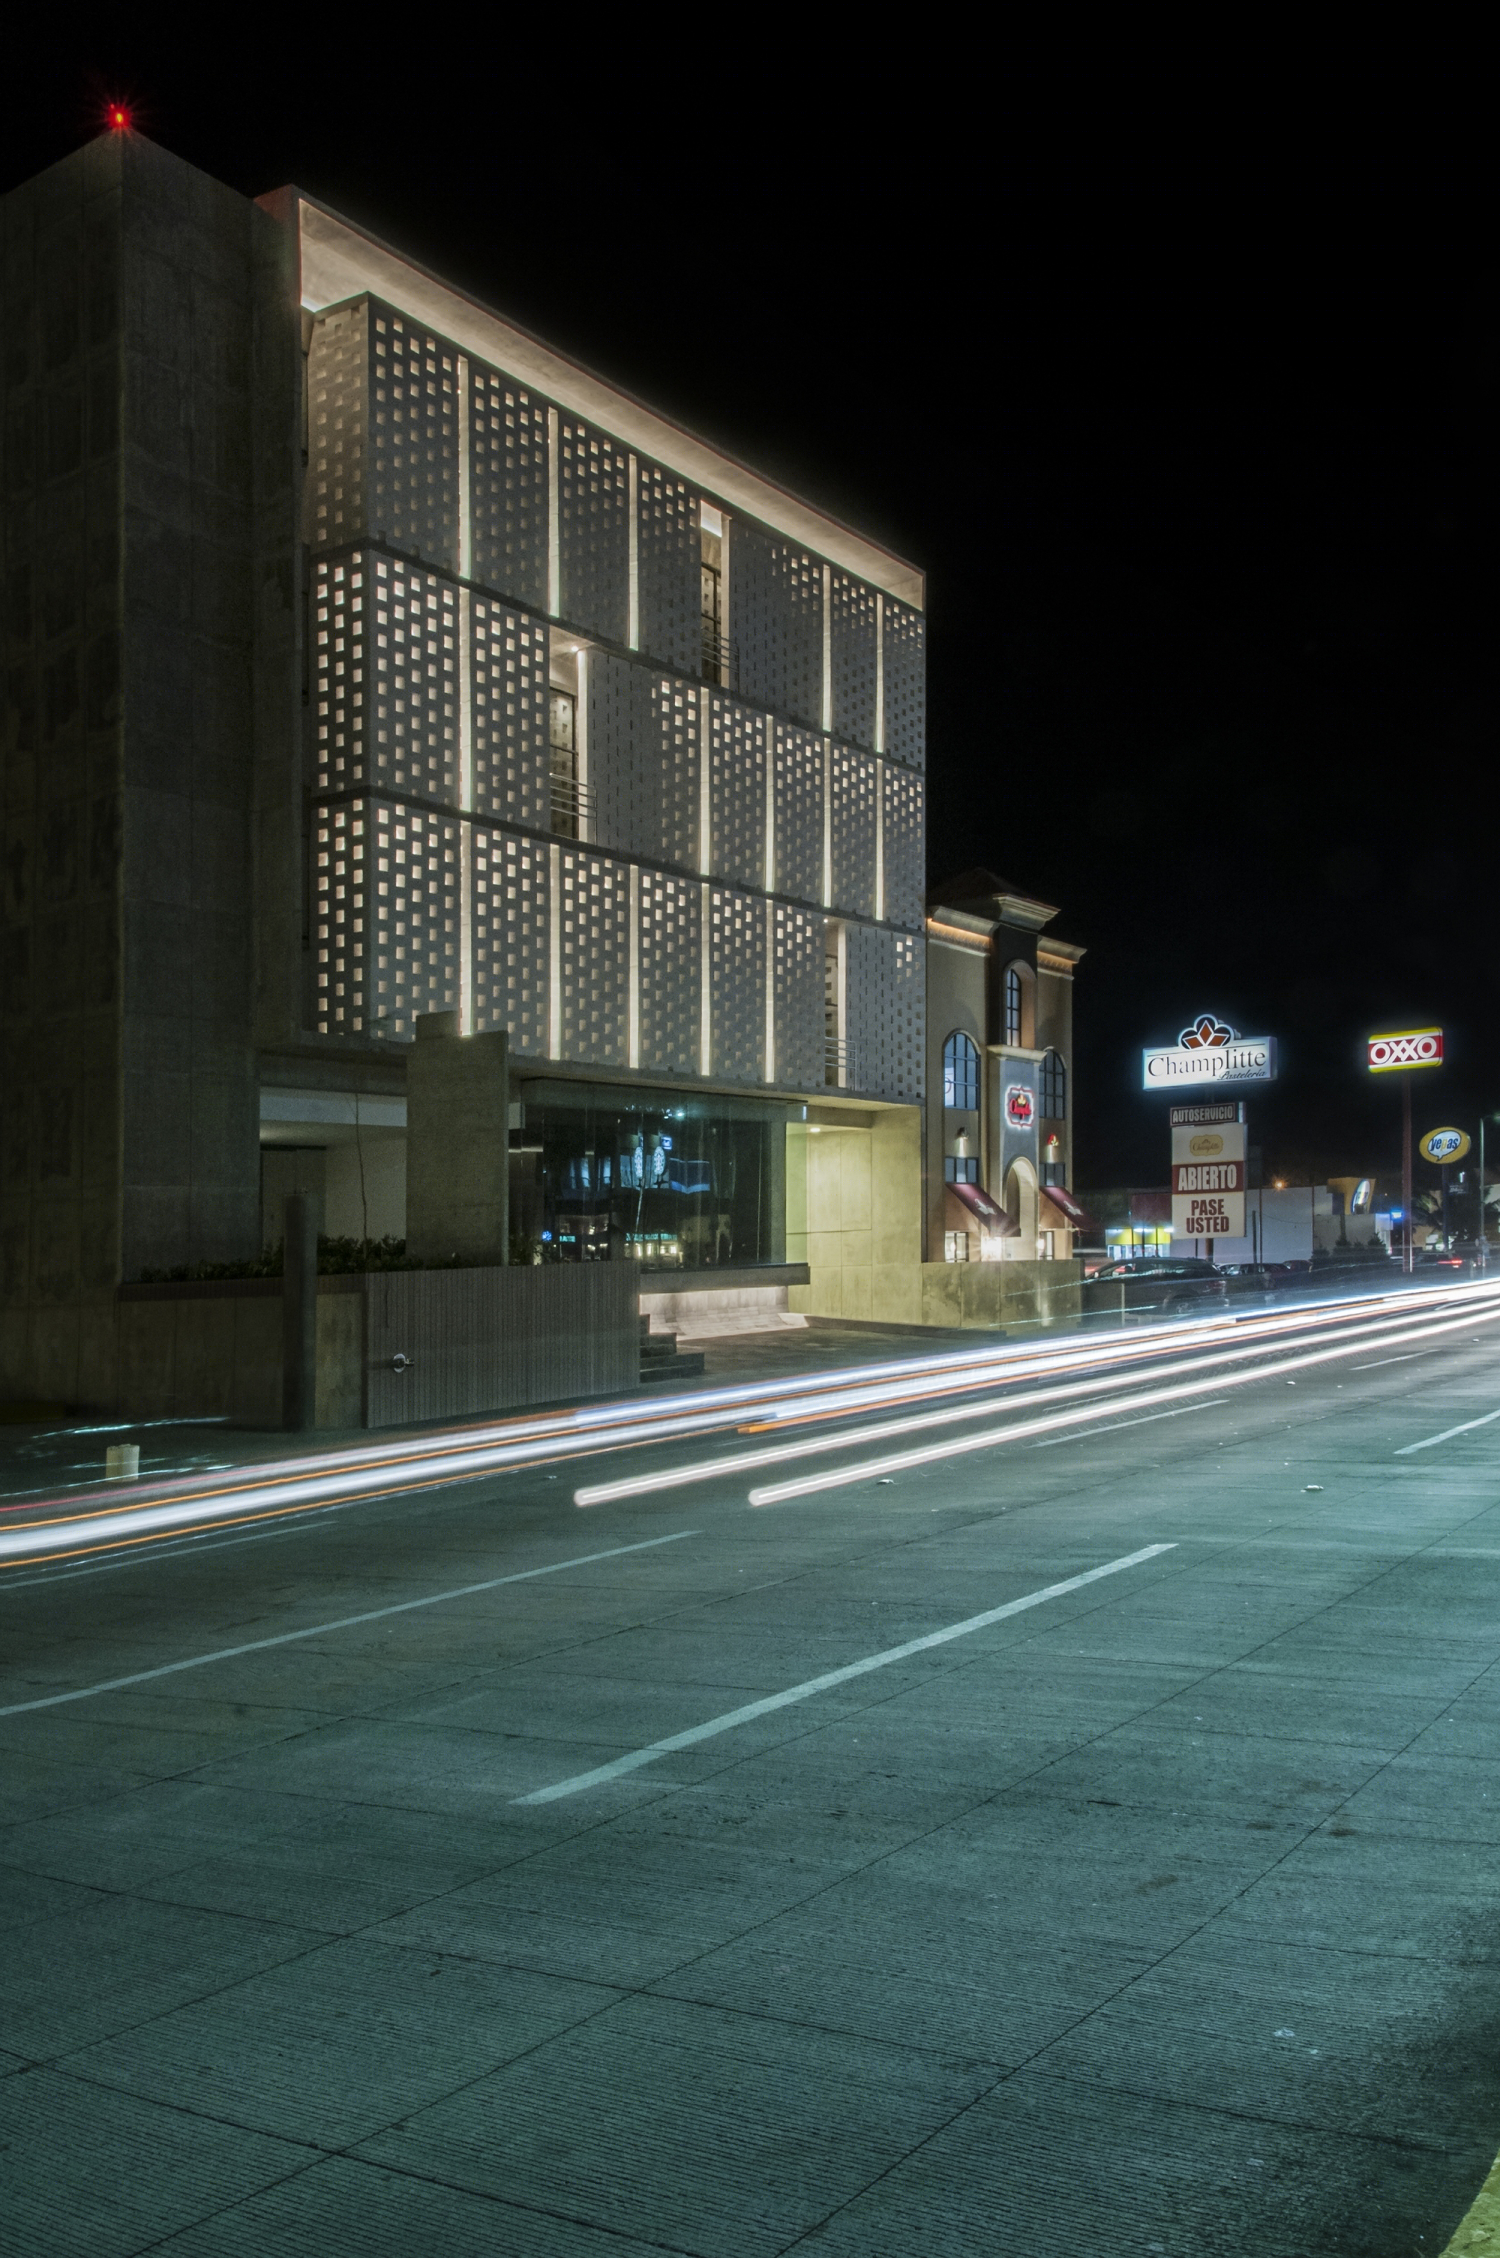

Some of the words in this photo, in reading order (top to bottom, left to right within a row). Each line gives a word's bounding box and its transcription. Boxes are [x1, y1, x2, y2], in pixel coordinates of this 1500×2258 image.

[1370, 1036, 1437, 1064] OXXO
[1148, 1049, 1266, 1077] Champlitte
[1172, 1106, 1233, 1123] AUTOSERVICIO
[1178, 1164, 1237, 1191] ABIERTO
[1191, 1199, 1225, 1216] PASE
[1186, 1216, 1229, 1234] USTED
